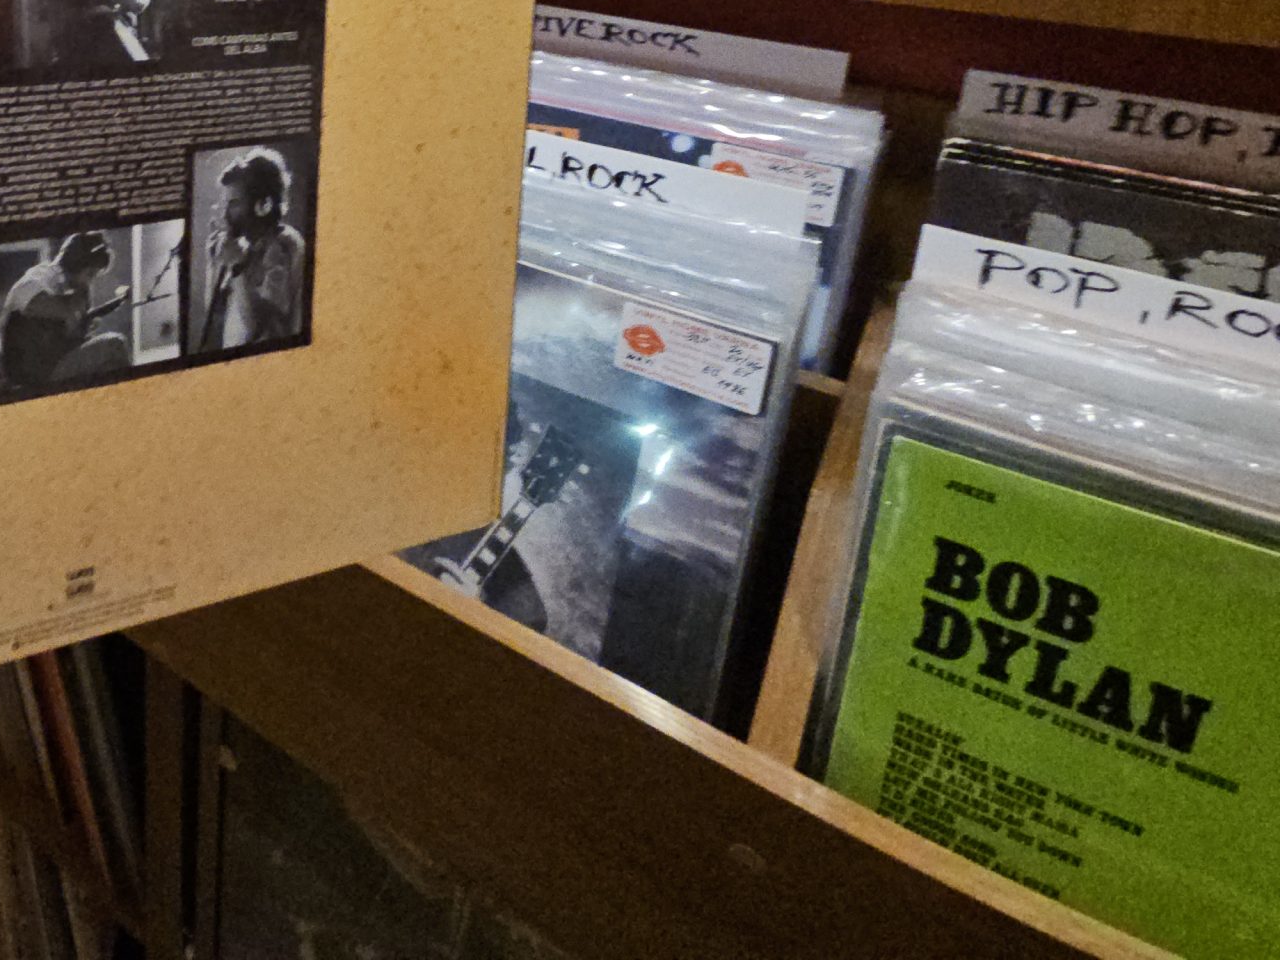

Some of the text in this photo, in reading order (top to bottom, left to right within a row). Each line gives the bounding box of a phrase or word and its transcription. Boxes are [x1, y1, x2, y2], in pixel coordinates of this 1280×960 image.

[600, 22, 700, 57] ROCK
[983, 82, 1099, 122] HIP
[560, 151, 669, 204] ROCK
[1165, 290, 1280, 339] RO
[924, 535, 1100, 644] BOB
[912, 595, 1213, 754] DYLAN
